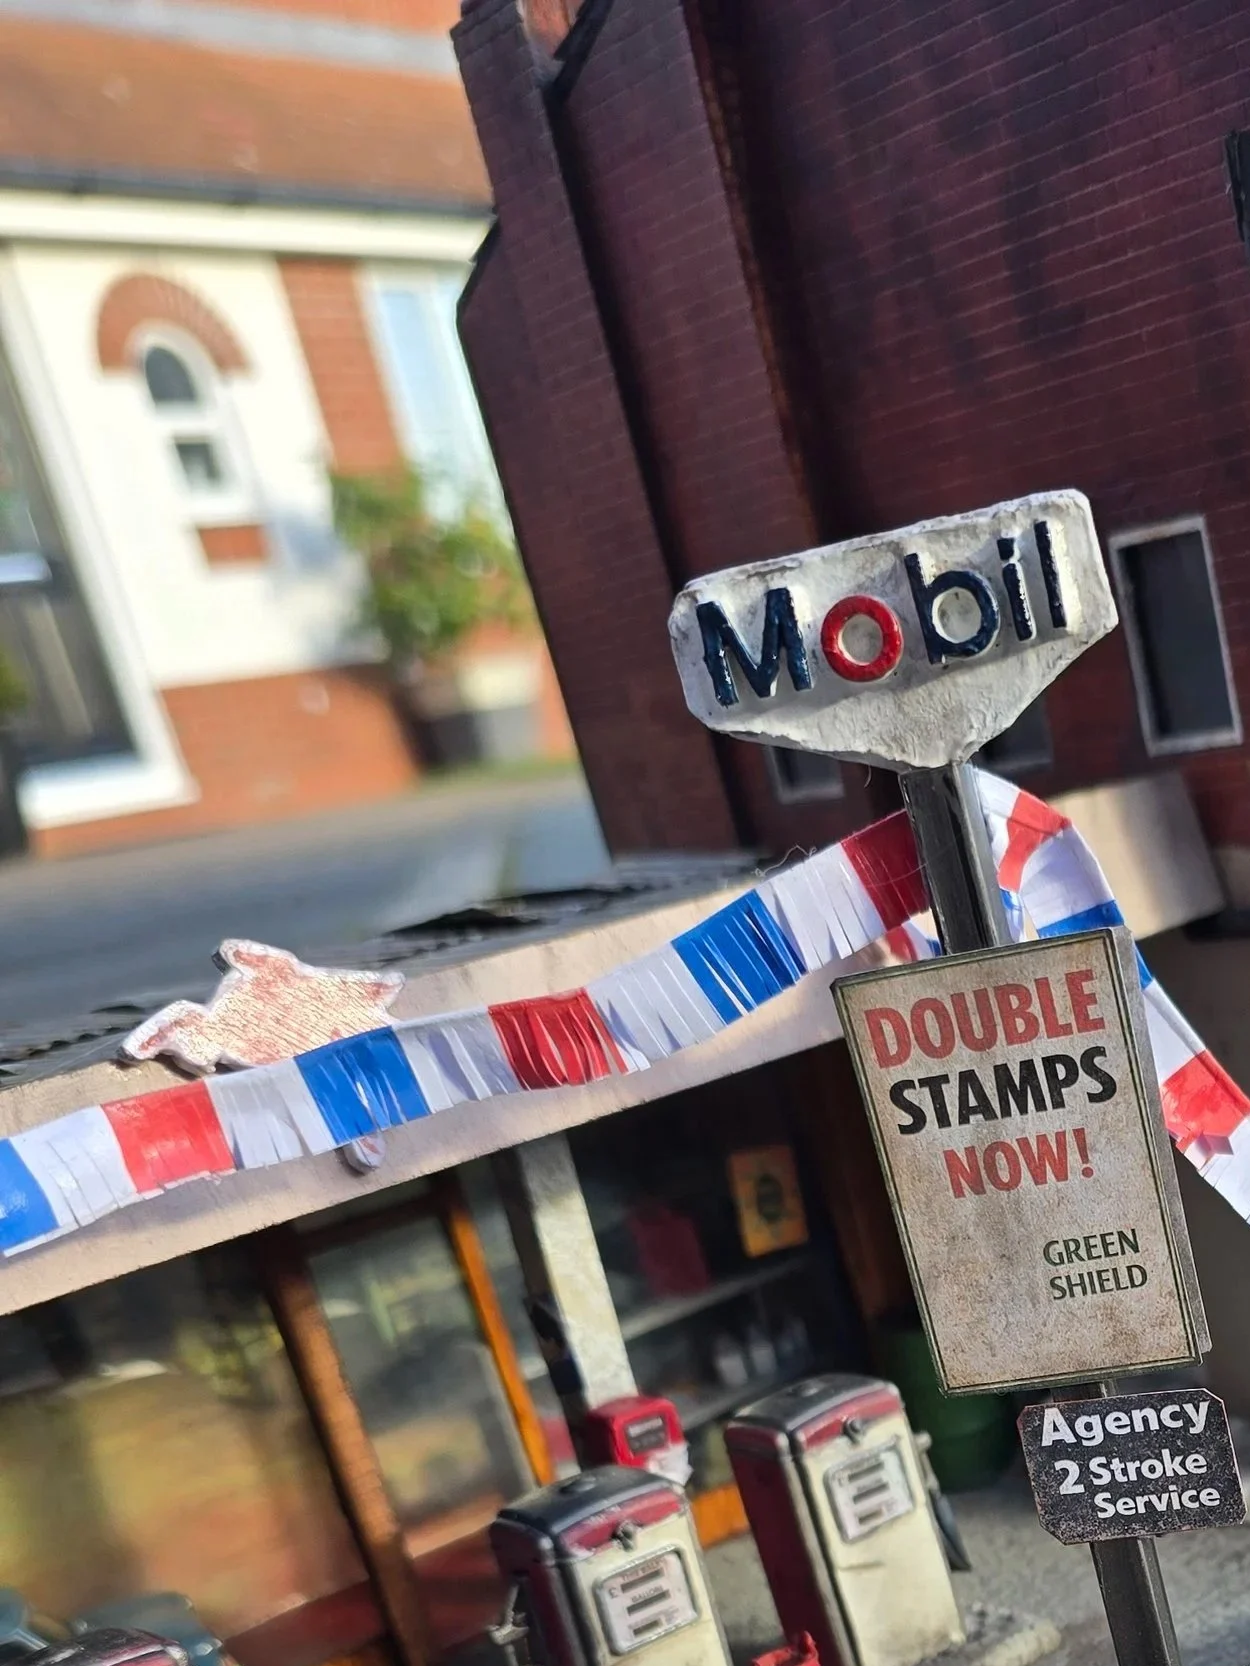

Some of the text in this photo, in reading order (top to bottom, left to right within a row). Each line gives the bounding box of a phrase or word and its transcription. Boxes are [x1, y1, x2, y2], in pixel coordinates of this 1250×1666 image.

[696, 520, 1068, 707] Mobil
[864, 968, 1106, 1069] DOUBLE
[889, 1046, 1118, 1135] STAMPS
[943, 1127, 1094, 1199] NOW!
[1042, 1228, 1141, 1267] GREEN
[1049, 1264, 1148, 1300] SHIELD
[1041, 1400, 1211, 1447] Agency
[1054, 1448, 1208, 1495] 2 Stroke
[1094, 1484, 1221, 1519] Service
